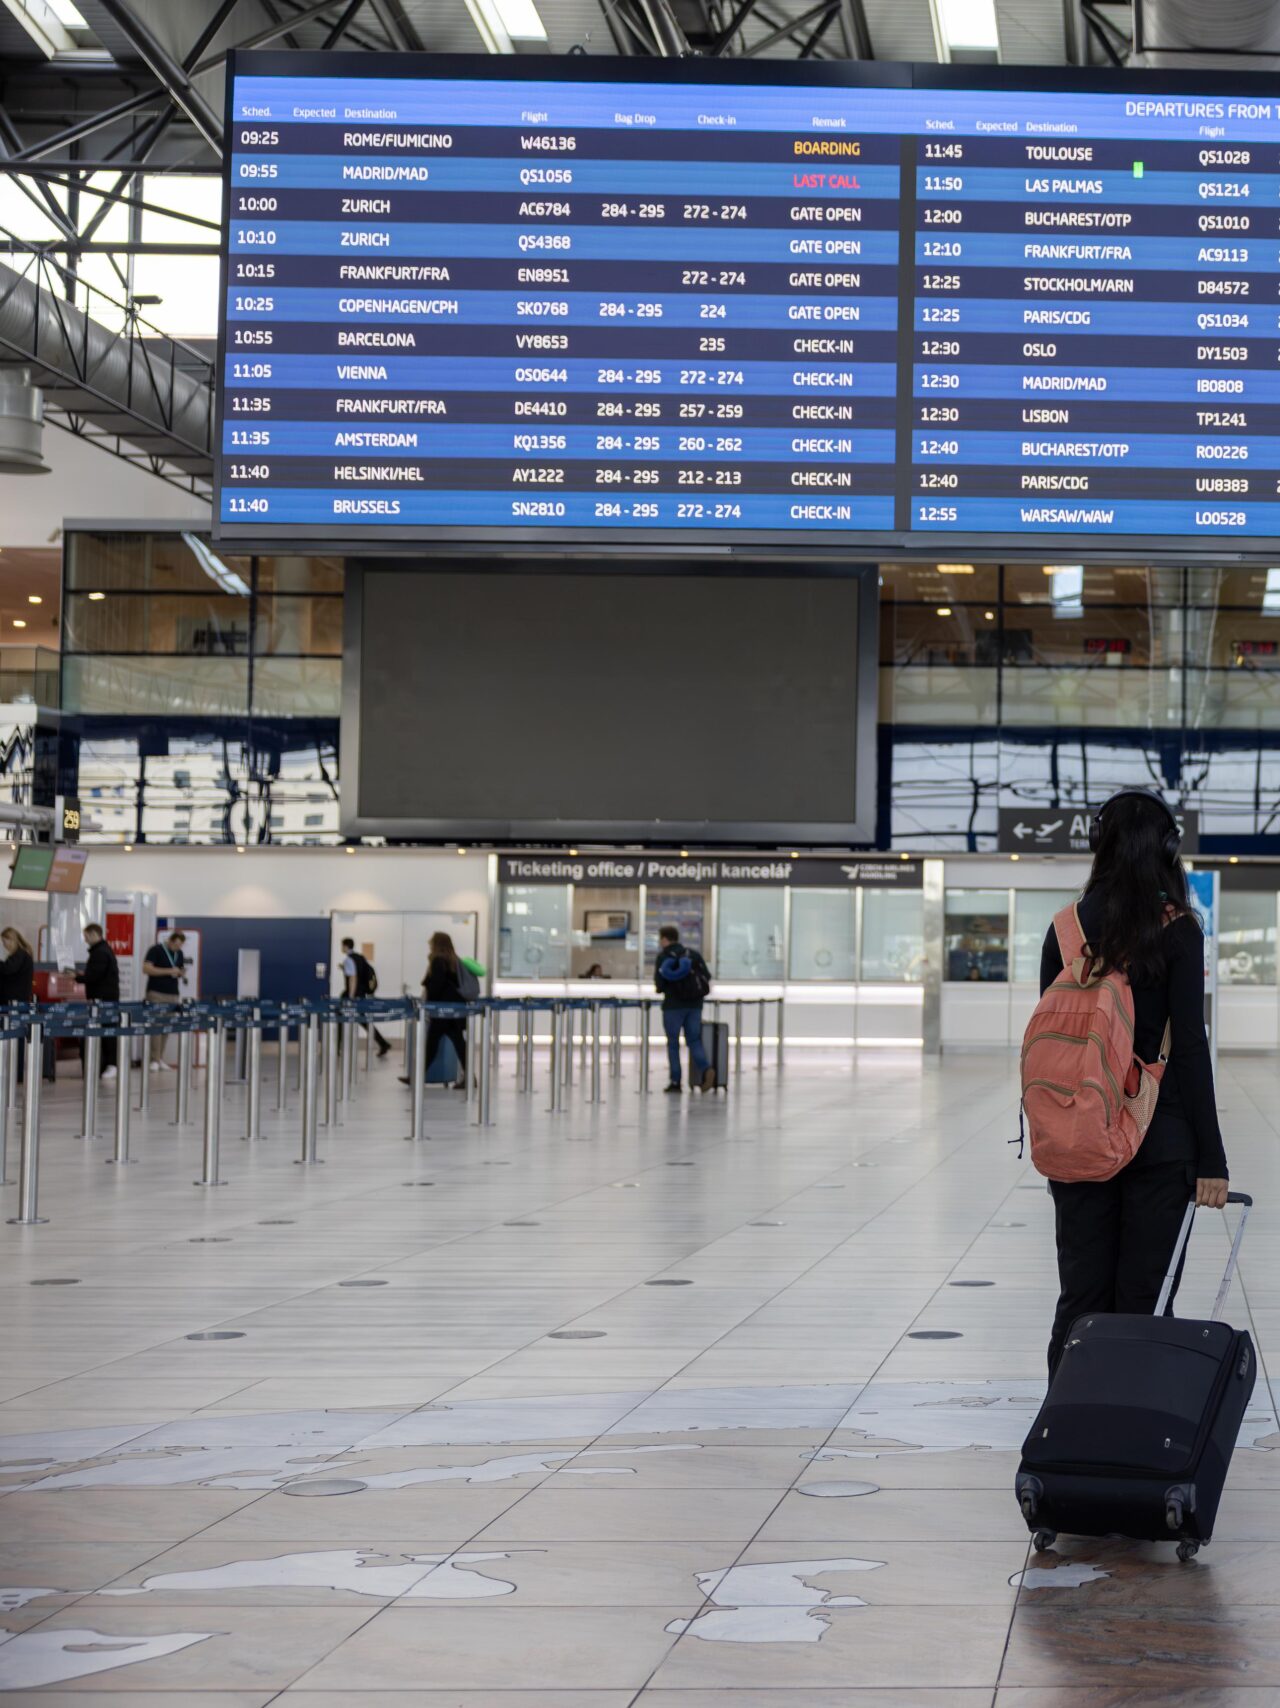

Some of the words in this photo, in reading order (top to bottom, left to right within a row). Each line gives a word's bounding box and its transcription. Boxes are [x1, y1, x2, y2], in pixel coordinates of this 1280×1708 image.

[241, 106, 273, 118] Sched.
[292, 106, 337, 120] Expected
[344, 107, 397, 119] Destination
[520, 111, 549, 123] Flight
[614, 112, 633, 125] Bag
[635, 113, 656, 126] Drop
[697, 114, 737, 126] Check-in
[811, 116, 847, 128] Remark
[1125, 101, 1224, 118] DEPARTURES
[1228, 104, 1271, 120] FROM
[925, 119, 956, 131] Sched.
[975, 120, 1019, 133] Expected
[1025, 121, 1078, 133] Destination
[1198, 125, 1226, 138] Flight
[240, 130, 279, 145] 09:25
[343, 132, 453, 149] ROME/FIUMICINO
[520, 135, 577, 151] W46136
[793, 140, 861, 157] BOARDING
[925, 143, 963, 159] 11:45
[1025, 145, 1093, 162] TOULOUSE
[1198, 149, 1251, 167] QS1028
[239, 163, 278, 178] 09:55
[342, 165, 429, 181] MADRID/MAD
[519, 168, 572, 186] QS1056
[793, 173, 826, 190] LAST
[828, 173, 861, 190] CALL
[924, 176, 963, 191] 11:50
[1025, 178, 1050, 194] LAS
[1052, 178, 1103, 194] PALMAS
[1198, 182, 1250, 199] QS1214
[238, 196, 278, 212] 10:00
[341, 198, 391, 214] ZURICH
[518, 201, 571, 217] AC6784
[790, 206, 823, 222] GATE
[825, 206, 862, 222] OPEN
[924, 209, 963, 224] 12:00
[1024, 211, 1132, 228] BUCHAREST/OTP
[1198, 215, 1250, 232] QS1010
[237, 229, 277, 245] 10:10
[340, 231, 390, 247] ZURICH
[518, 234, 571, 252] QS4368
[923, 241, 962, 257] 12:10
[1024, 244, 1132, 260] FRANKFURT/FRA
[1197, 247, 1249, 263] AC9113
[236, 263, 275, 278] 10:15
[339, 265, 451, 281] FRANKFURT/FRA
[517, 267, 570, 283] EN8951
[923, 274, 961, 290] 12:25
[1023, 277, 1134, 293] STOCKHOLM/ARN
[1197, 280, 1250, 296] D84572
[235, 296, 274, 312] 10:25
[338, 298, 459, 315] COPENHAGEN/CPH
[516, 301, 569, 316] SK0768
[700, 304, 727, 319] 224
[922, 307, 961, 323] 12:25
[1023, 309, 1091, 325] PARIS/CDG
[1197, 313, 1249, 330] QS1034
[234, 329, 273, 345] 10:55
[338, 331, 416, 347] BARCELONA
[515, 334, 569, 350] VY8653
[699, 337, 726, 352] 235
[793, 338, 854, 354] CHECK-IN
[922, 340, 961, 356] 12:30
[1022, 342, 1057, 358] OSLO
[1197, 346, 1248, 361] DY1503
[233, 363, 272, 378] 11:05
[336, 365, 388, 380] VIENNA
[921, 373, 960, 389] 12:30
[1022, 375, 1107, 391] MADRID/MAD
[1197, 379, 1244, 394] IB0808
[232, 396, 272, 412] 11:35
[336, 398, 447, 415] FRANKFURT/FRA
[514, 401, 567, 416] DE4410
[921, 407, 960, 422] 12:30
[1022, 408, 1069, 424] LISBON
[1195, 411, 1248, 427] TP1241
[231, 430, 270, 446] 11:35
[334, 432, 418, 448] AMSTERDAM
[513, 434, 567, 452] KQ1356
[920, 440, 959, 455] 12:40
[1021, 441, 1130, 458] BUCHAREST/OTP
[230, 464, 270, 479] 11:40
[334, 465, 425, 482] HELSINKI/HEL
[512, 468, 565, 483] AY1222
[920, 473, 959, 489] 12:40
[1021, 475, 1089, 491] PARIS/CDG
[1195, 478, 1249, 493] UU8383
[229, 498, 269, 513] 11:40
[333, 499, 401, 515] BRUSSELS
[511, 501, 565, 517] SN2810
[790, 505, 851, 520] CHECK-IN
[919, 506, 958, 521] 12:55
[1020, 508, 1114, 524] WARSAW/WAW
[507, 860, 584, 880] Ticketing
[587, 861, 634, 877] office
[648, 862, 718, 881] Prodejní
[721, 861, 793, 878] kancelář
